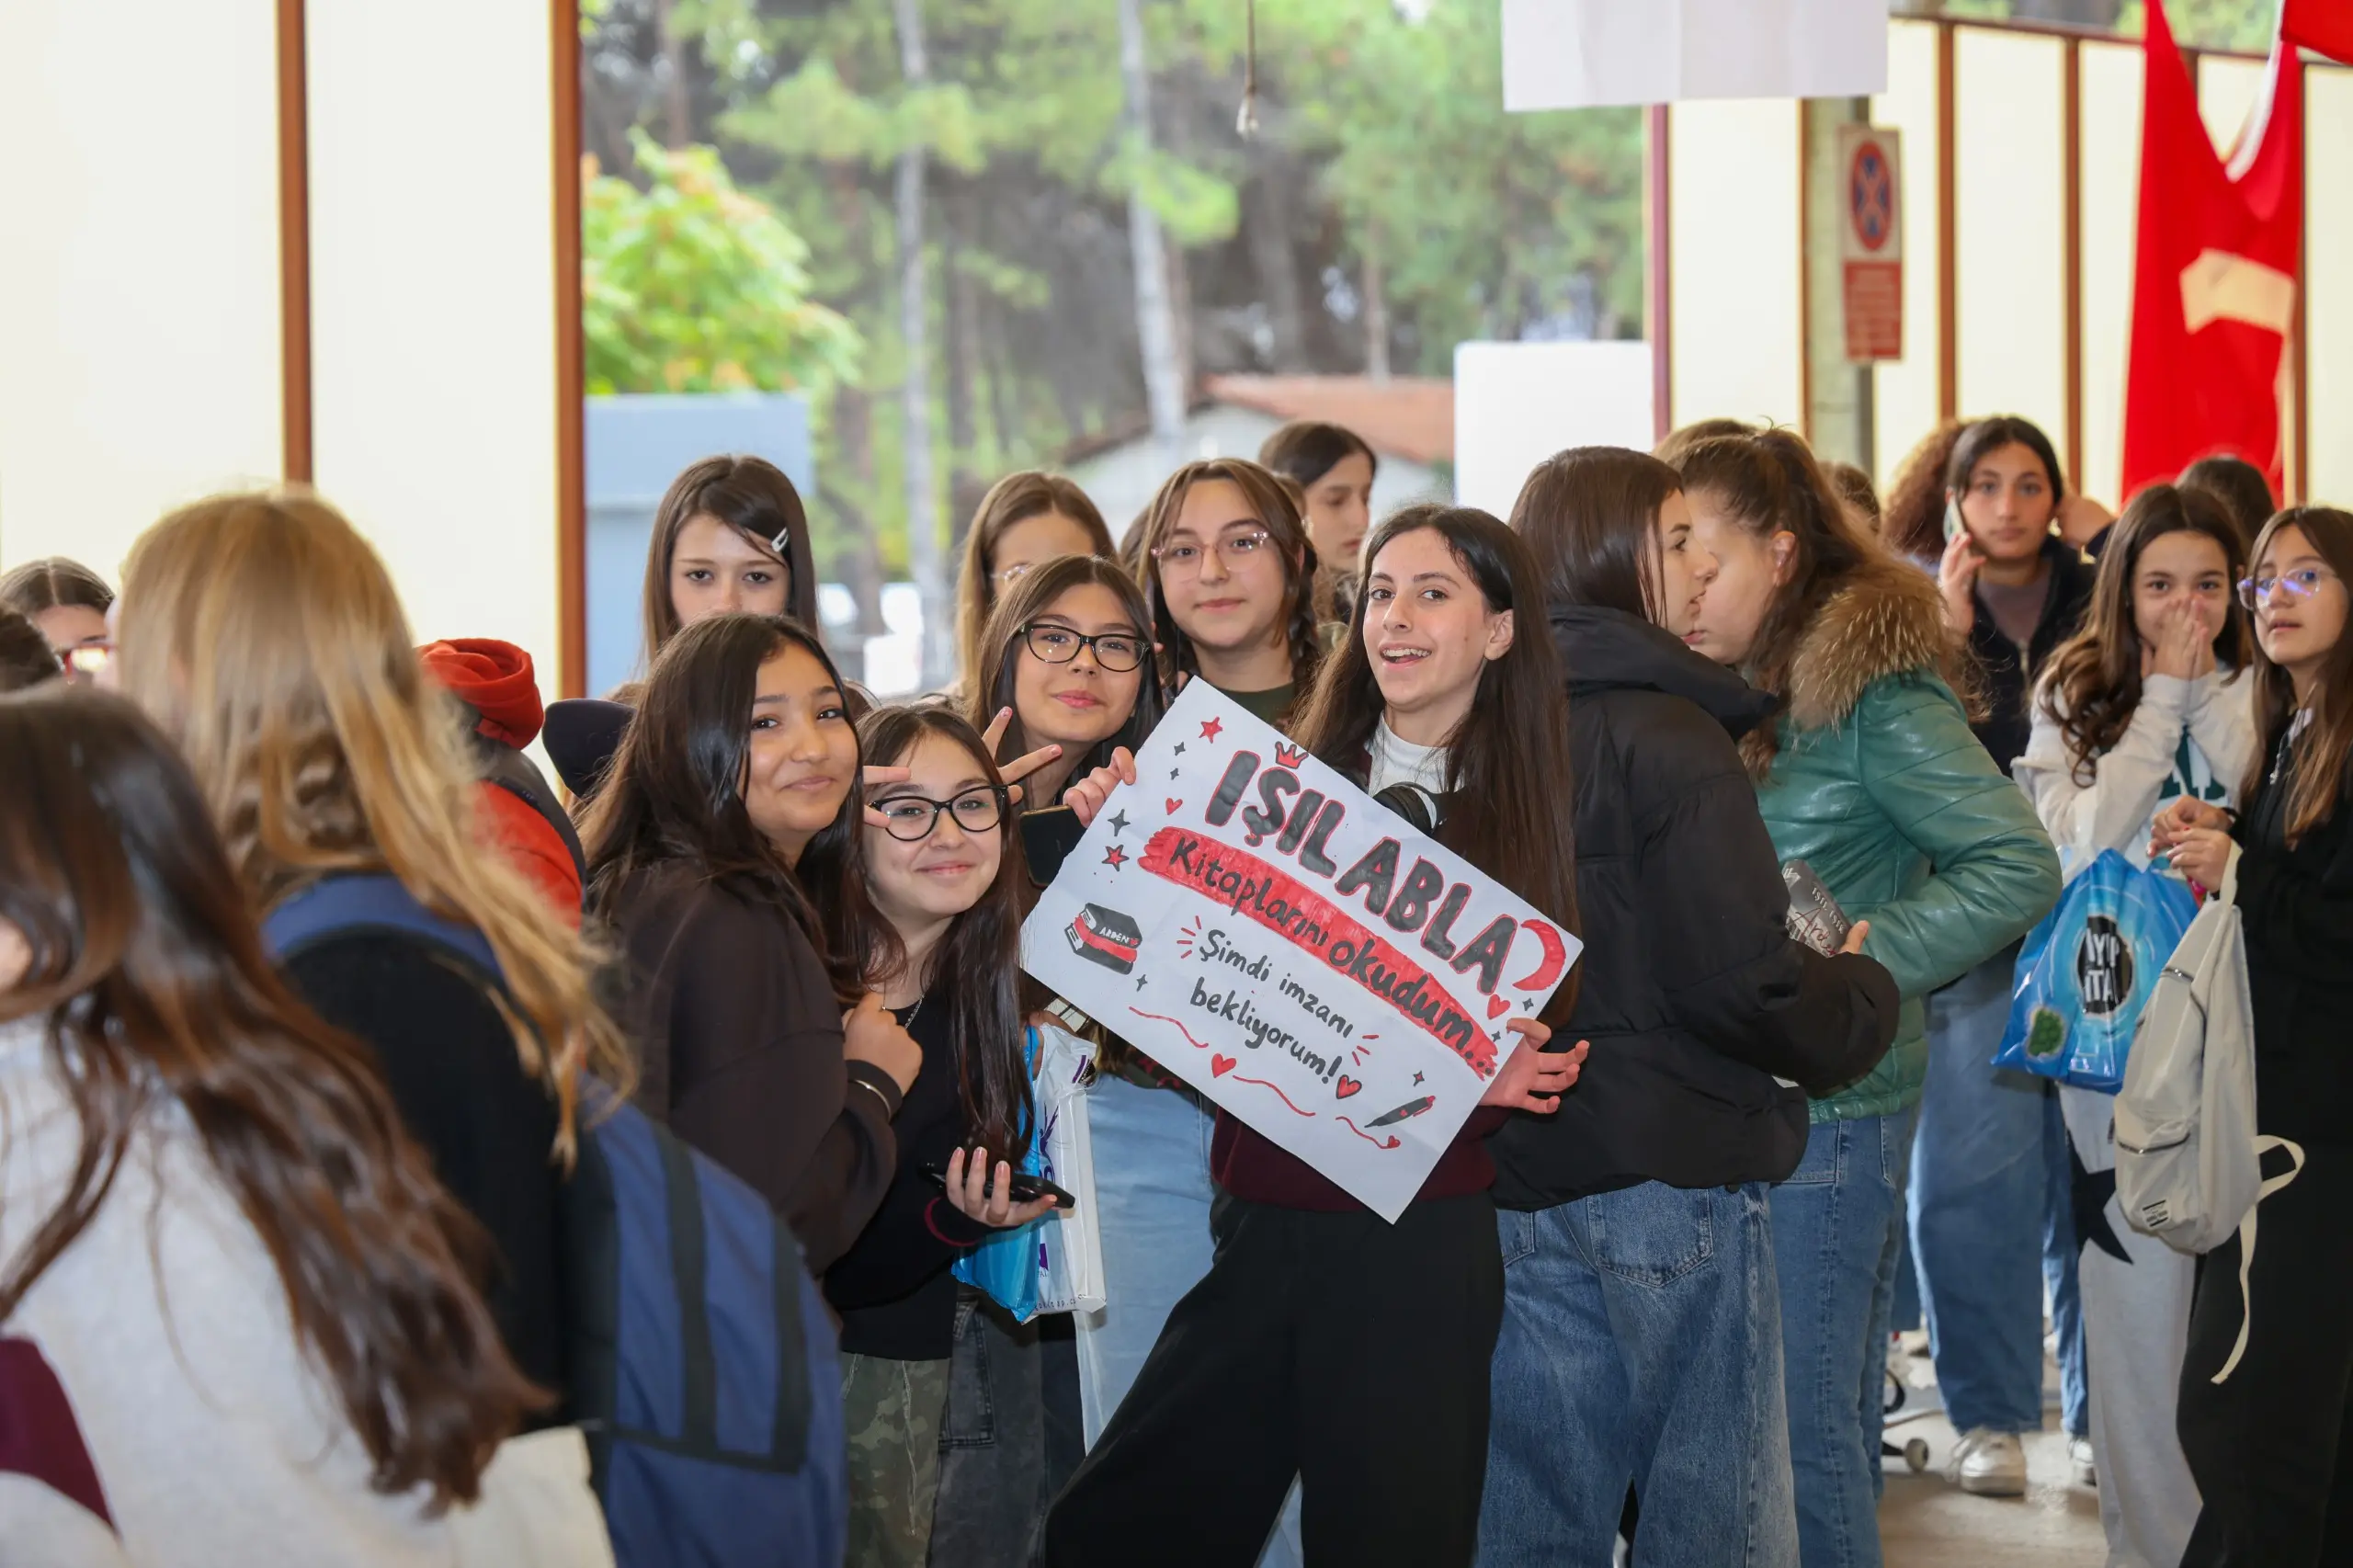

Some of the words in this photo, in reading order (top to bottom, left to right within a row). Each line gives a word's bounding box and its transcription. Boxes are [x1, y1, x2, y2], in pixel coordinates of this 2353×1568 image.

[1167, 835, 1329, 949] Kitaplarını
[1204, 749, 1347, 879] IŞIL
[1335, 836, 1518, 995] ABLA
[1098, 926, 1130, 944] ARDEN
[1199, 928, 1270, 983] Şimdi
[1279, 971, 1354, 1039] imzanı
[1189, 976, 1341, 1084] bekliyorum!
